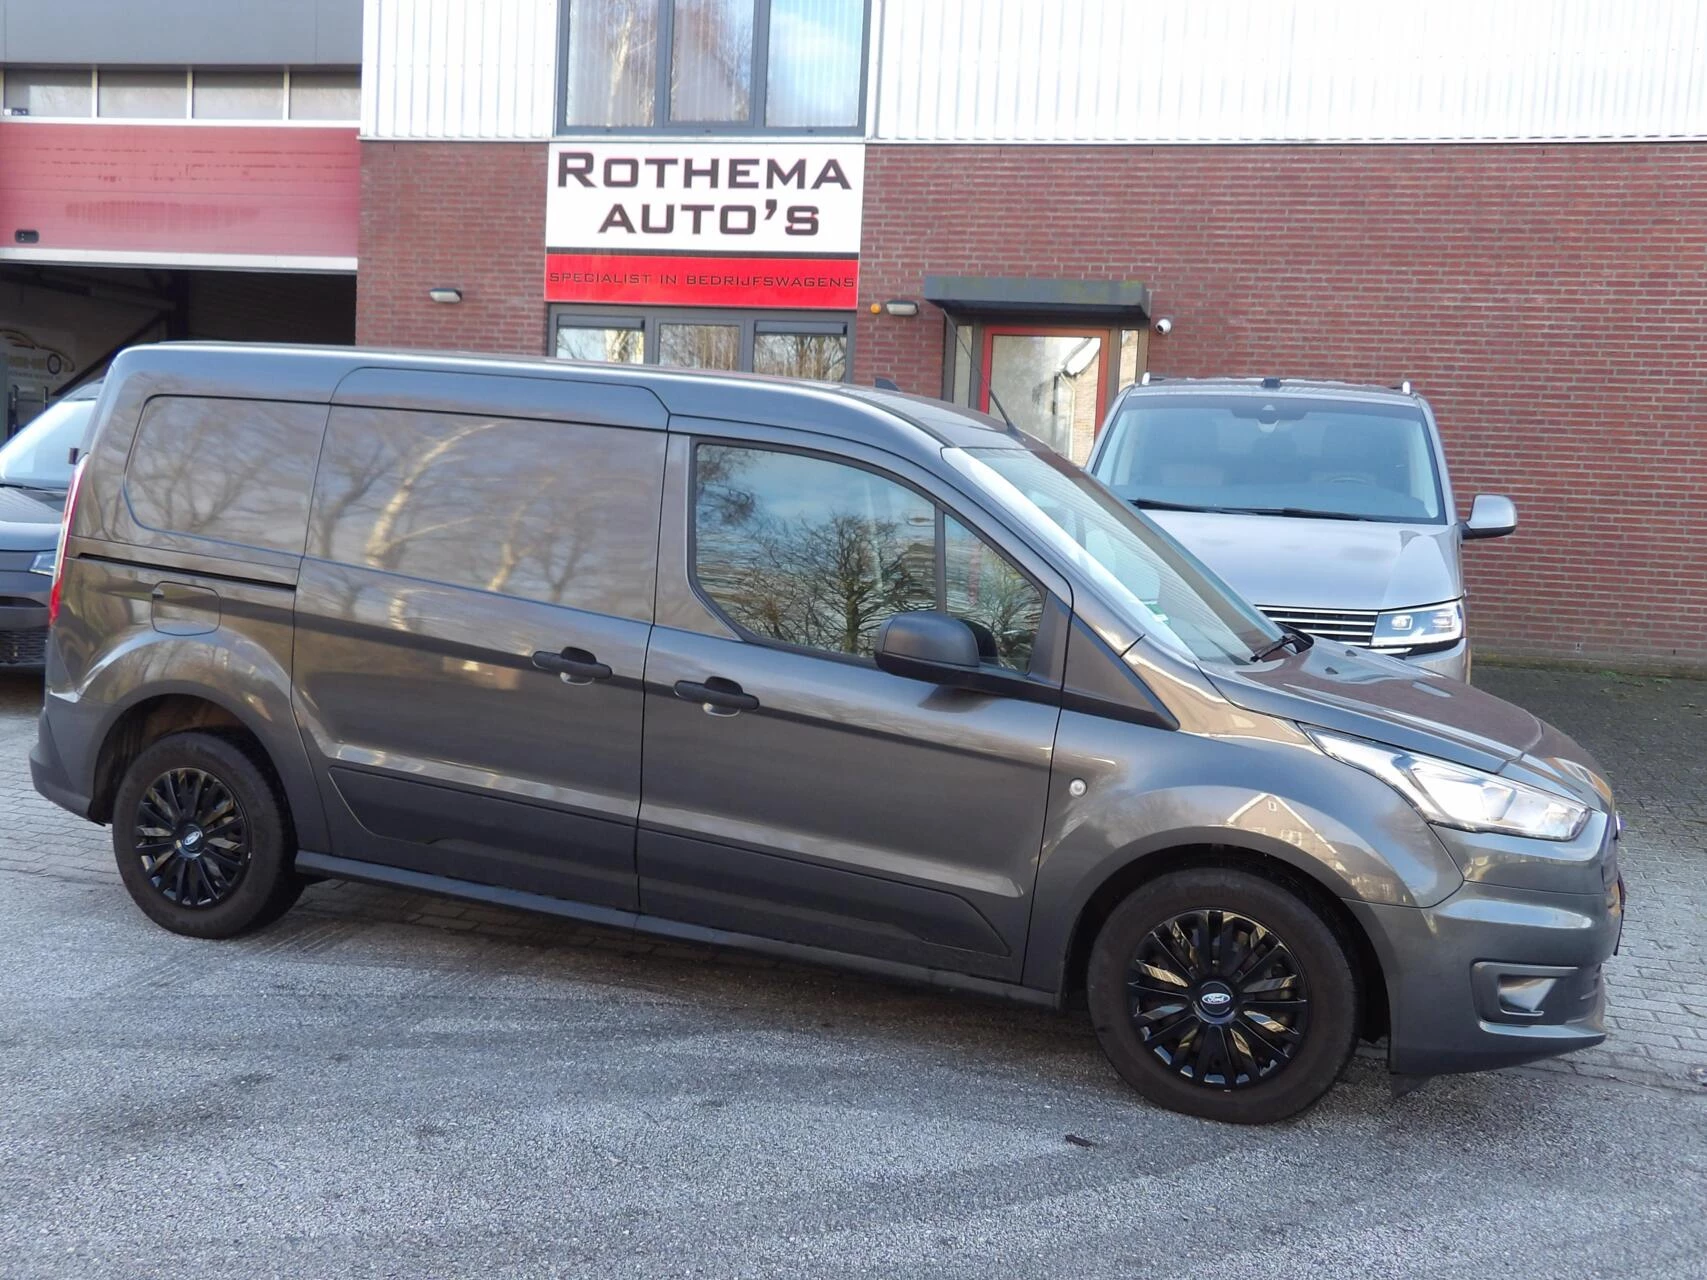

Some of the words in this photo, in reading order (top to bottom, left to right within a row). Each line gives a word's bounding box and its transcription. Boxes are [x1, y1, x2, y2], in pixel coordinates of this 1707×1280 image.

[558, 152, 852, 190] ROTHEMA
[598, 199, 820, 236] AUTO'S
[549, 272, 652, 284] SPECIALIST
[660, 274, 677, 285] IN
[686, 275, 855, 288] BEDRIJFSWAGENS
